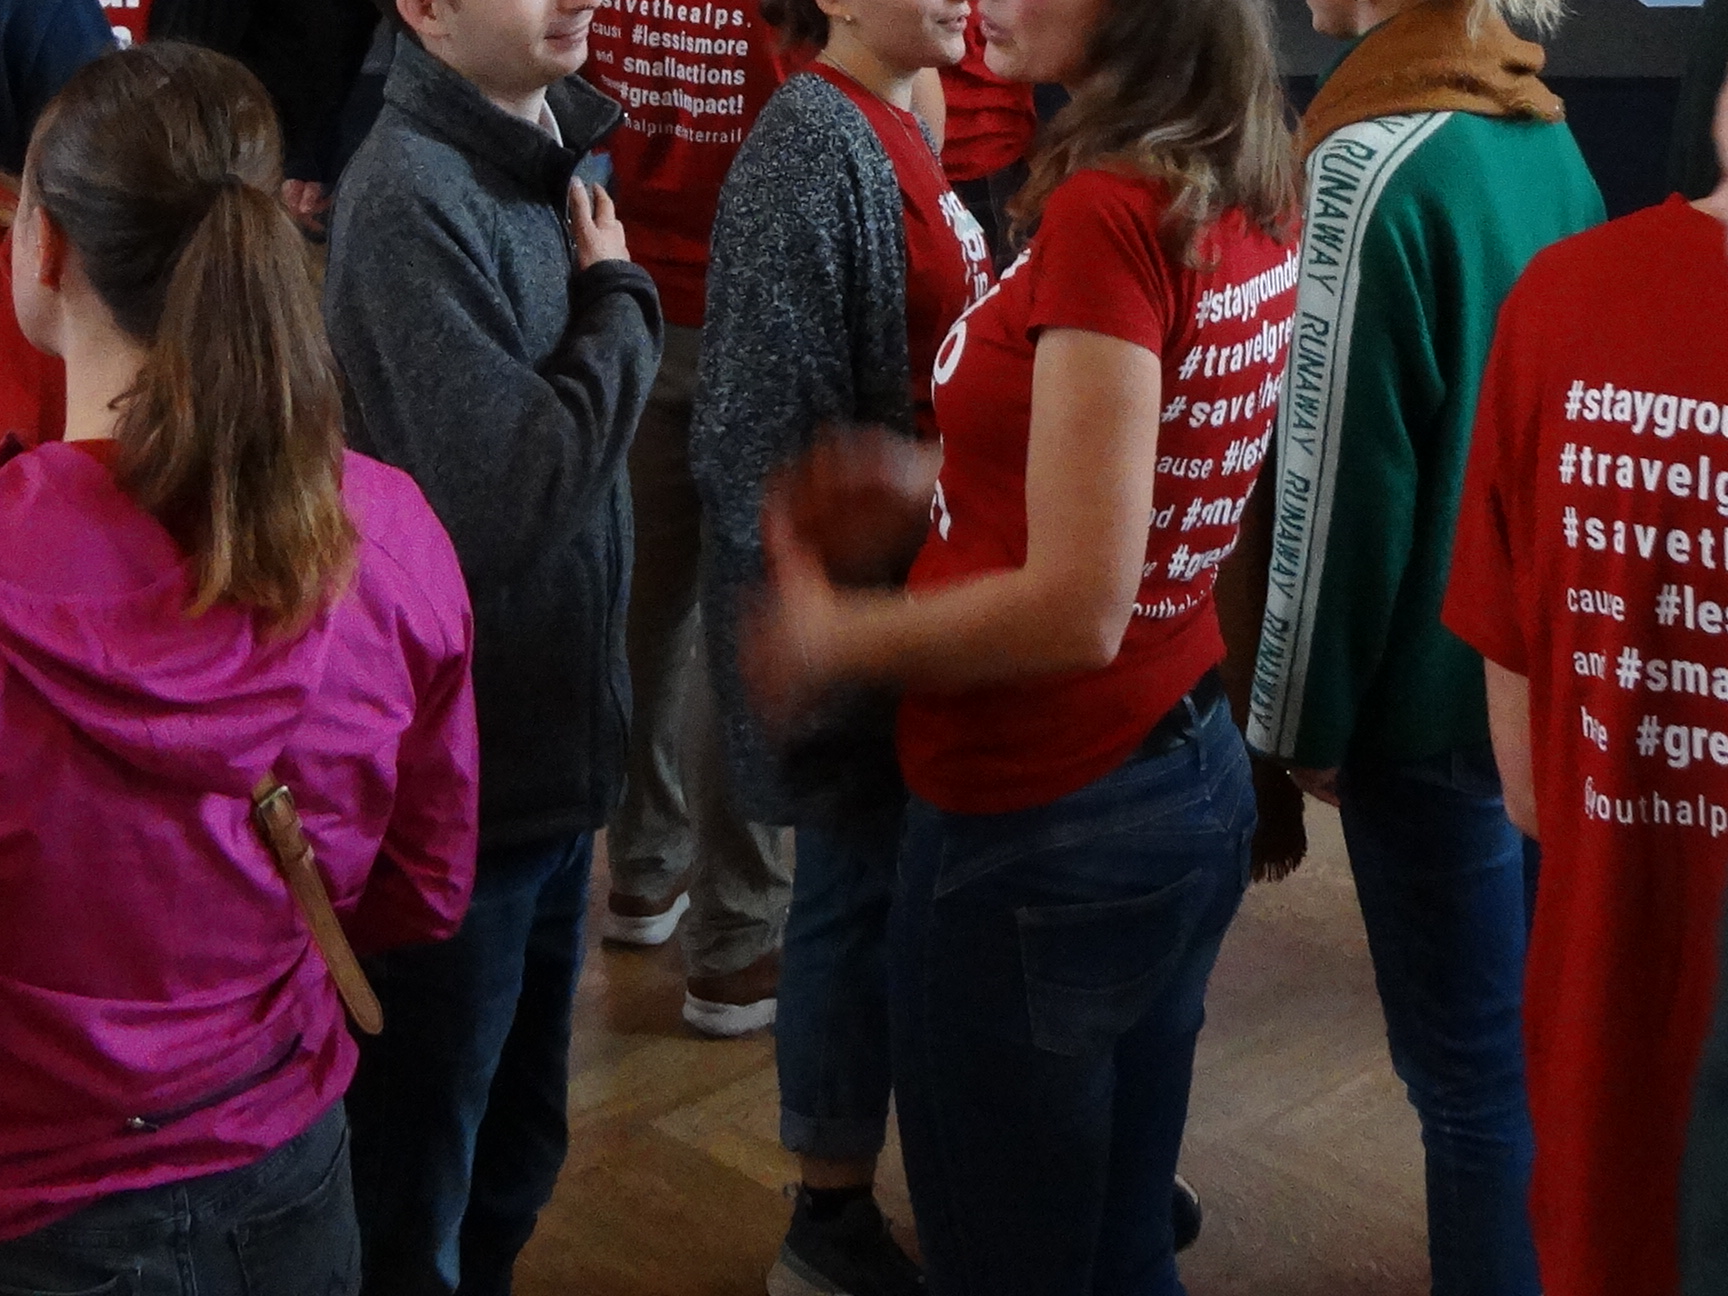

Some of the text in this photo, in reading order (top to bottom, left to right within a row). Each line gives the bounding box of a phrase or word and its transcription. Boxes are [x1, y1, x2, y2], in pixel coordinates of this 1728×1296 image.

[632, 24, 749, 56] #lessismore
[1307, 138, 1378, 297] RUNAWAY
[1291, 311, 1330, 457] RUNAWAY
[1156, 454, 1214, 480] ause
[1271, 469, 1311, 600] RUNAWAY
[1566, 586, 1626, 622] caue
